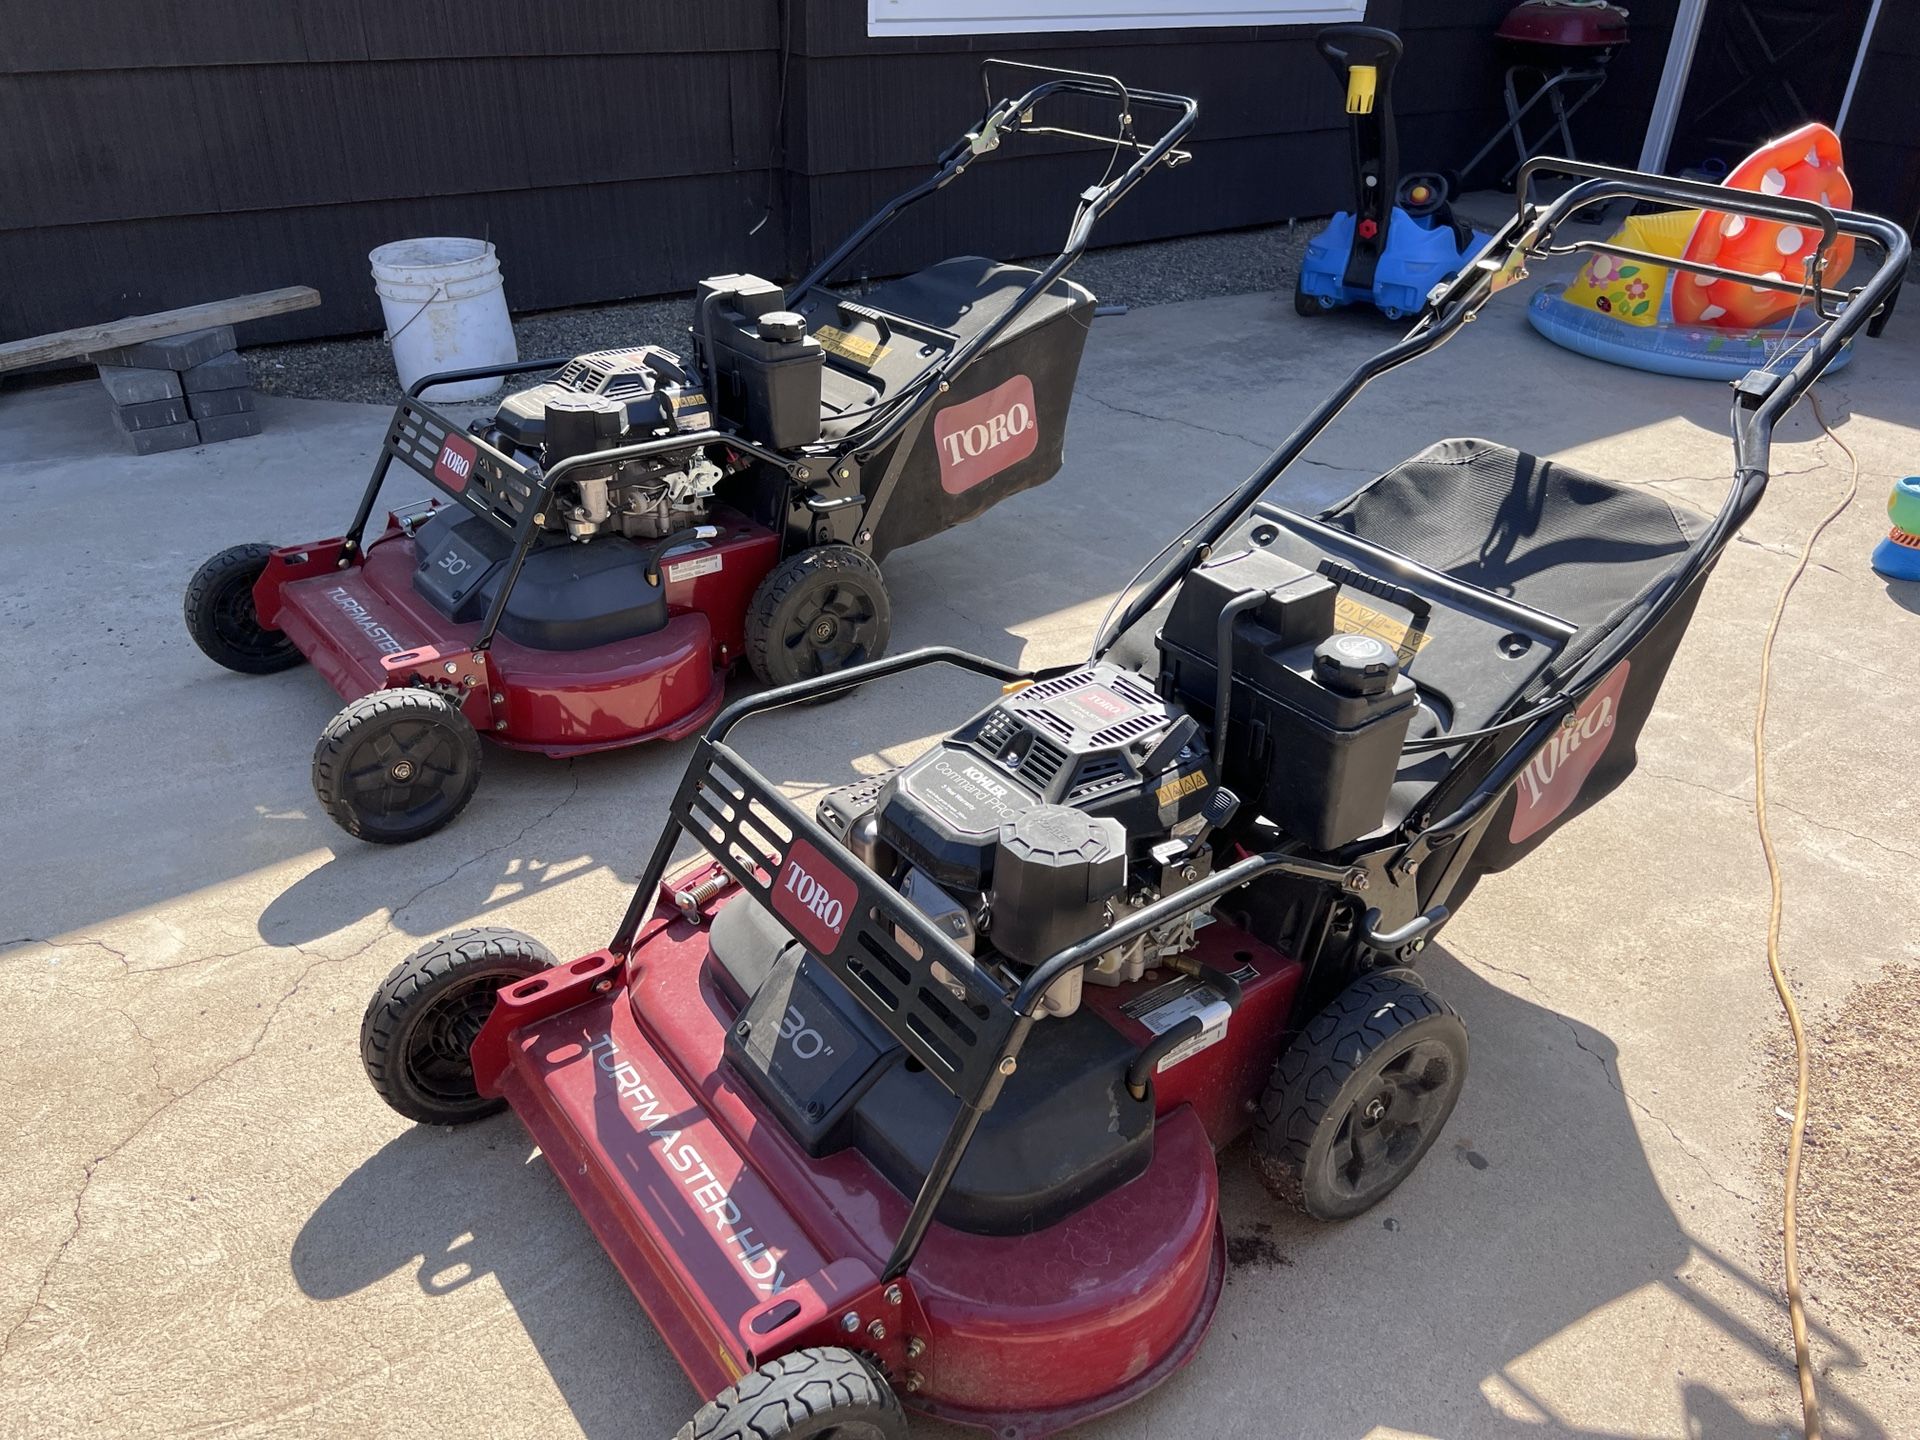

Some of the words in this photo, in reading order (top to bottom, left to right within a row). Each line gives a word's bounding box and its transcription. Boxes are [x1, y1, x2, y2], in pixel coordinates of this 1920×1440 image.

[935, 762, 989, 800] Command
[962, 766, 1008, 798] KOHLER
[956, 793, 976, 810] Warranty
[784, 861, 843, 928] TORO
[588, 1033, 742, 1232] TURFMASTER
